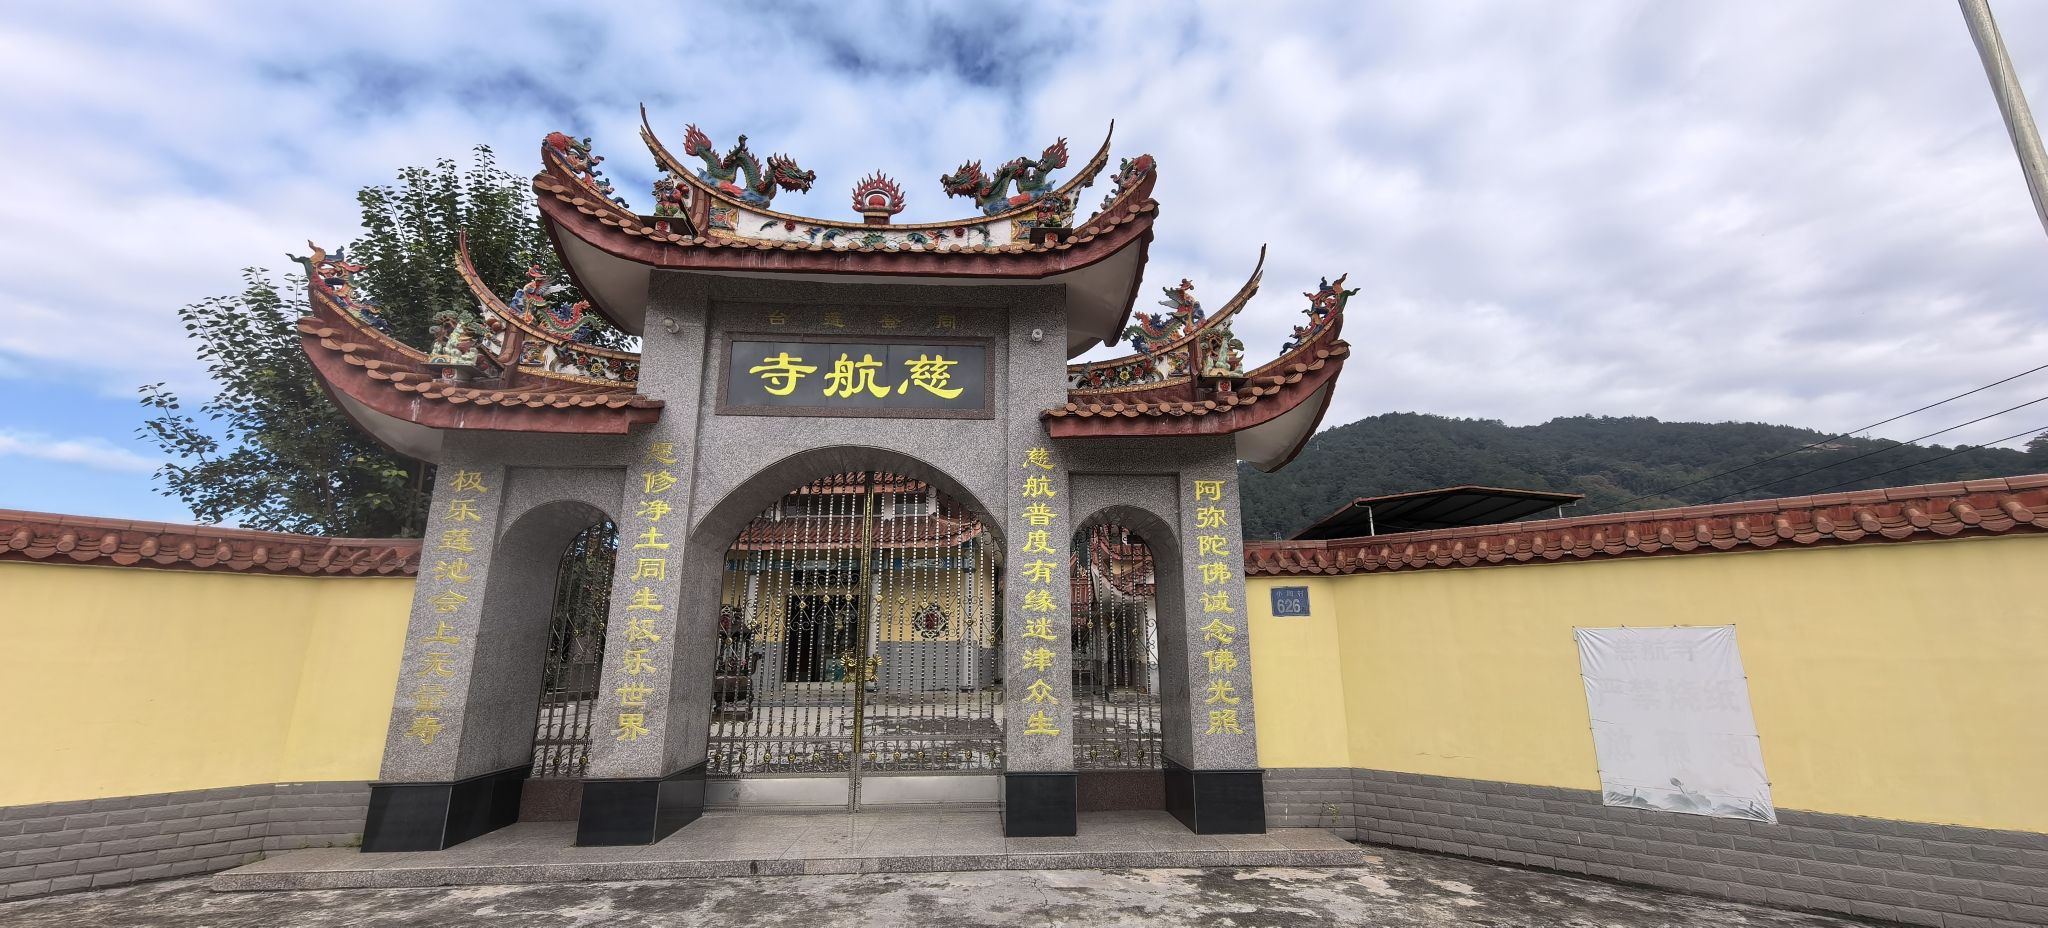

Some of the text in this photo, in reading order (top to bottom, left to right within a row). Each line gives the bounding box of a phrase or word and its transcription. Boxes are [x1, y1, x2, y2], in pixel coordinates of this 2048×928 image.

[749, 352, 964, 400] 慈航寺
[407, 469, 488, 744] 极乐莲池会上无量寿
[1022, 447, 1060, 736] 慈航普度有缘迷津众生
[1194, 479, 1245, 735] 阿弥陀佛诚念佛光照
[1277, 598, 1301, 614] 626
